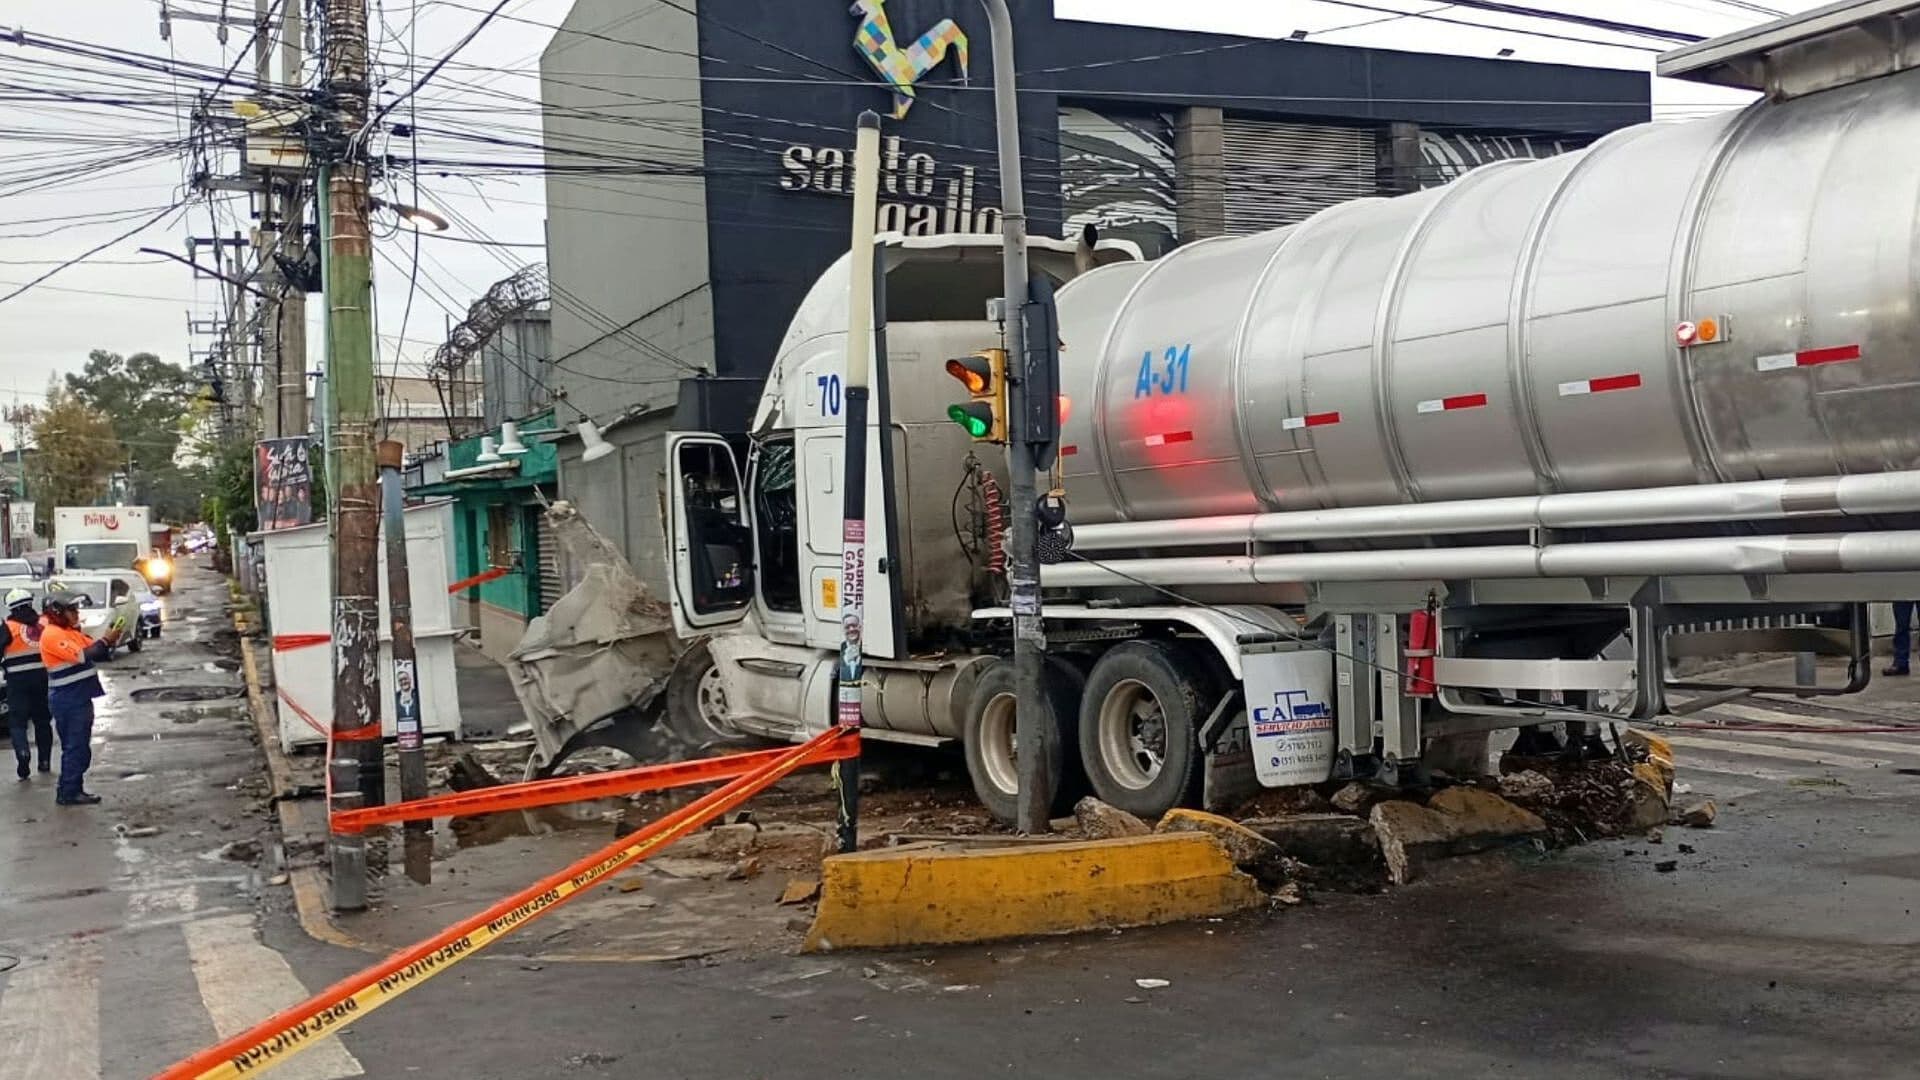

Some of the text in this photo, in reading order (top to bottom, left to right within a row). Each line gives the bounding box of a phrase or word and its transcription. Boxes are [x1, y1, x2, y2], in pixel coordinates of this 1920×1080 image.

[780, 135, 936, 197] sato
[818, 374, 840, 417] 70
[1135, 344, 1191, 400] A-31
